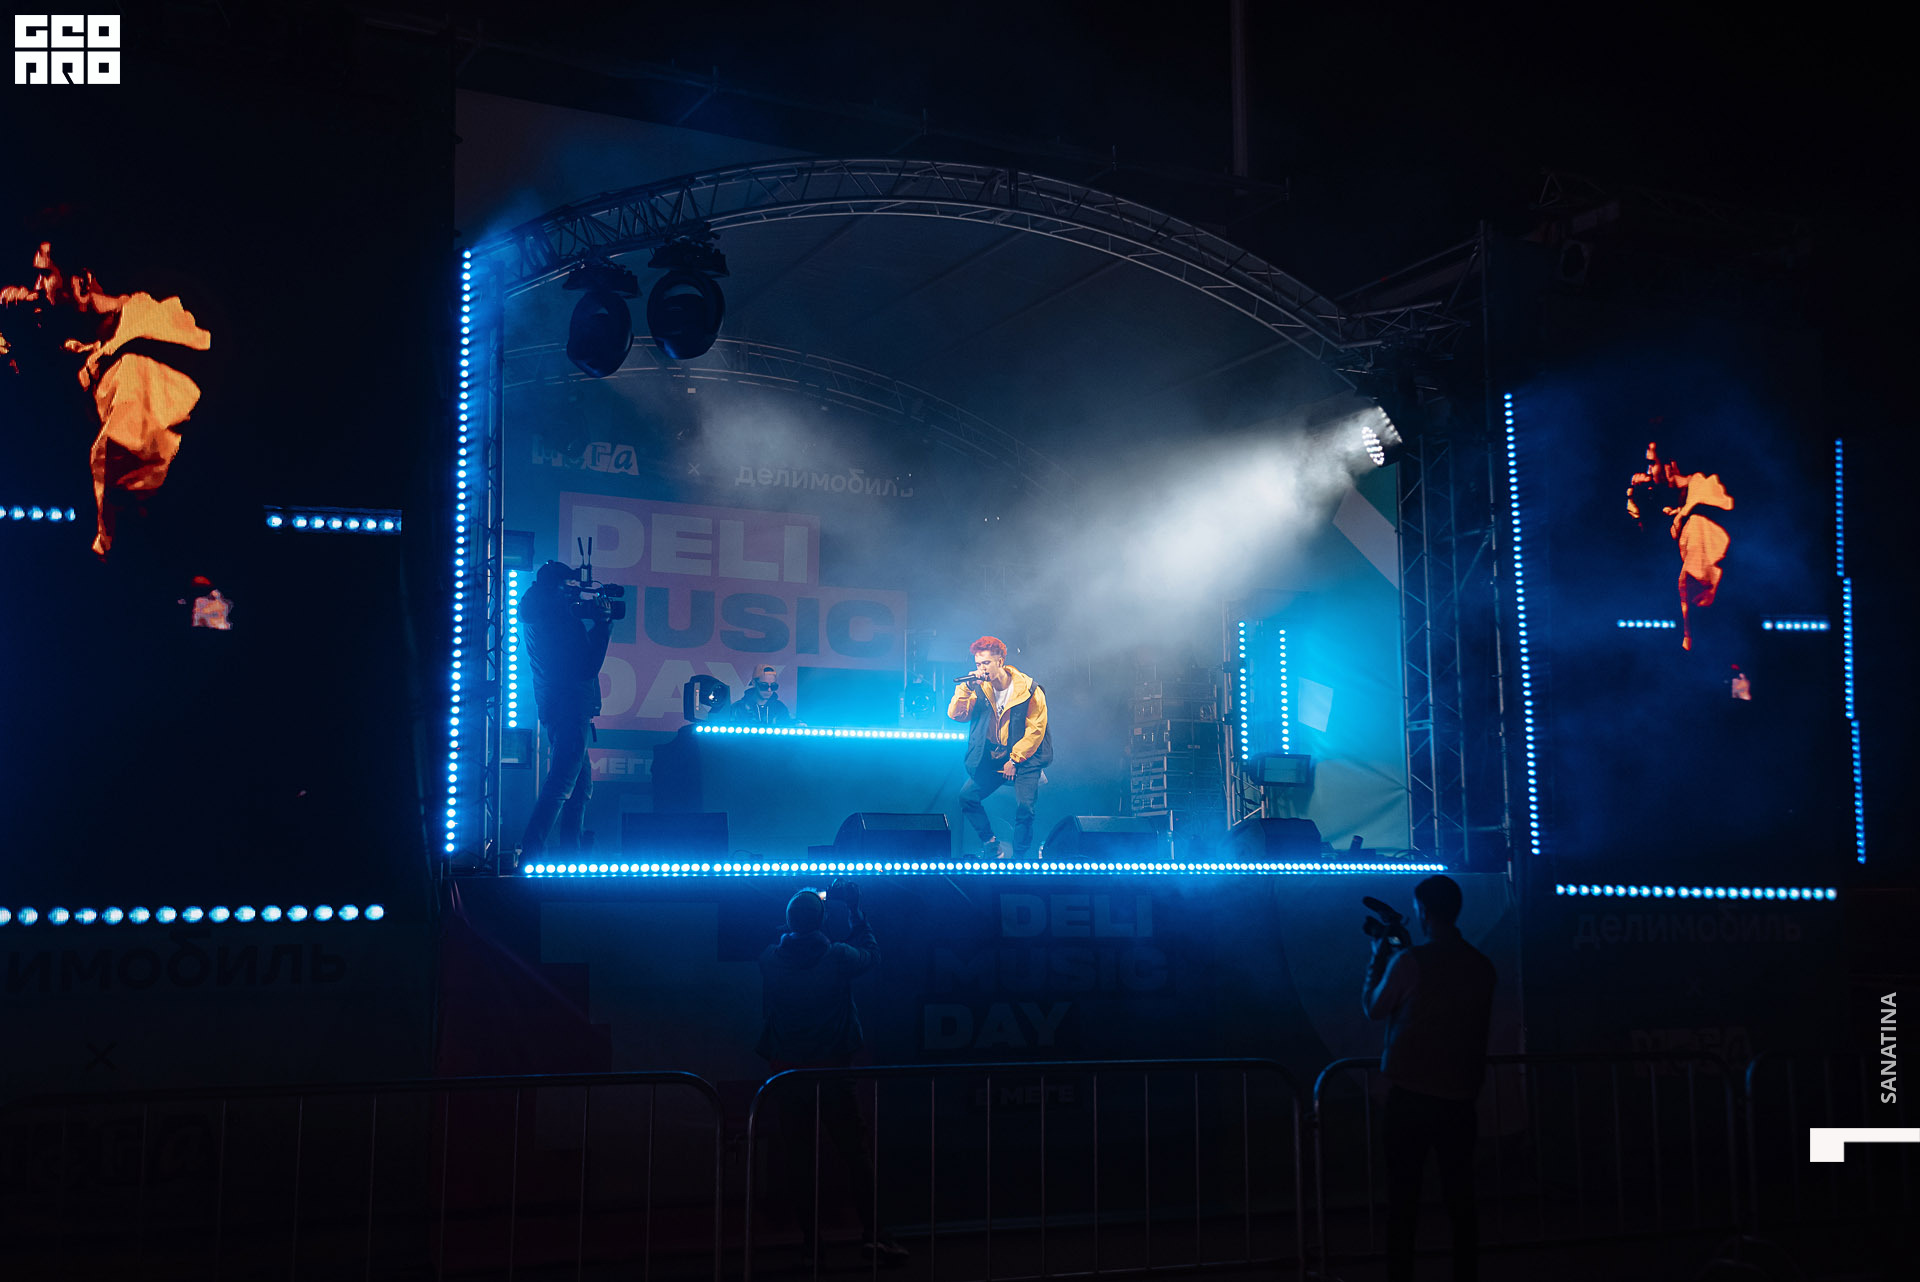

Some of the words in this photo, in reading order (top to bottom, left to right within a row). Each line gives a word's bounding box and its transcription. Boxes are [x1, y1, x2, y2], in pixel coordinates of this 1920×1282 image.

[572, 505, 809, 584] DELI
[1000, 893, 1153, 938] DELI
[1572, 903, 1801, 950] делимобиль
[5, 928, 346, 993] имобиль
[933, 946, 1169, 992] MUSIC
[923, 1001, 1073, 1050] DAY
